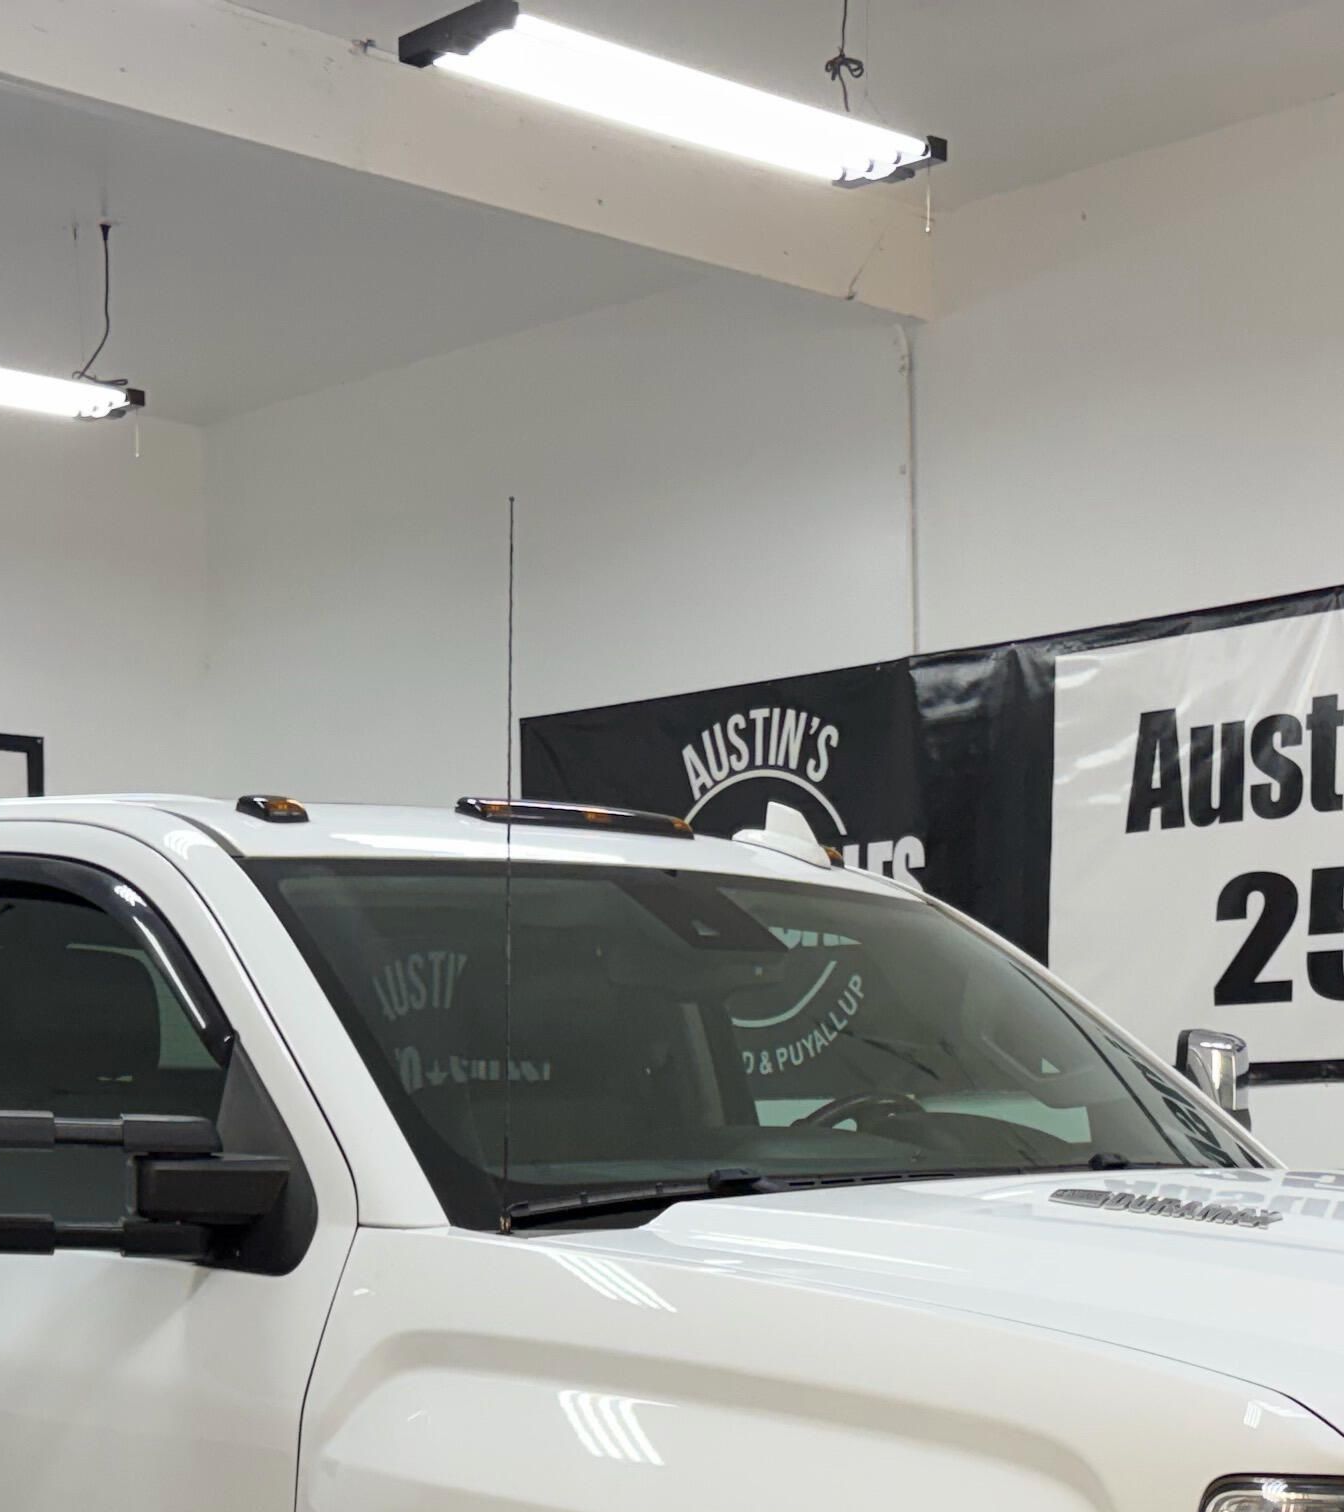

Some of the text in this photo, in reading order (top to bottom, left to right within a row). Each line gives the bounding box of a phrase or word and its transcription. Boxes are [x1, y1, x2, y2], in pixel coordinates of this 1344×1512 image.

[681, 707, 840, 801] AUSTIN'S
[775, 974, 865, 1073] PUYALLUP
[1104, 1191, 1284, 1231] DURAMAX
